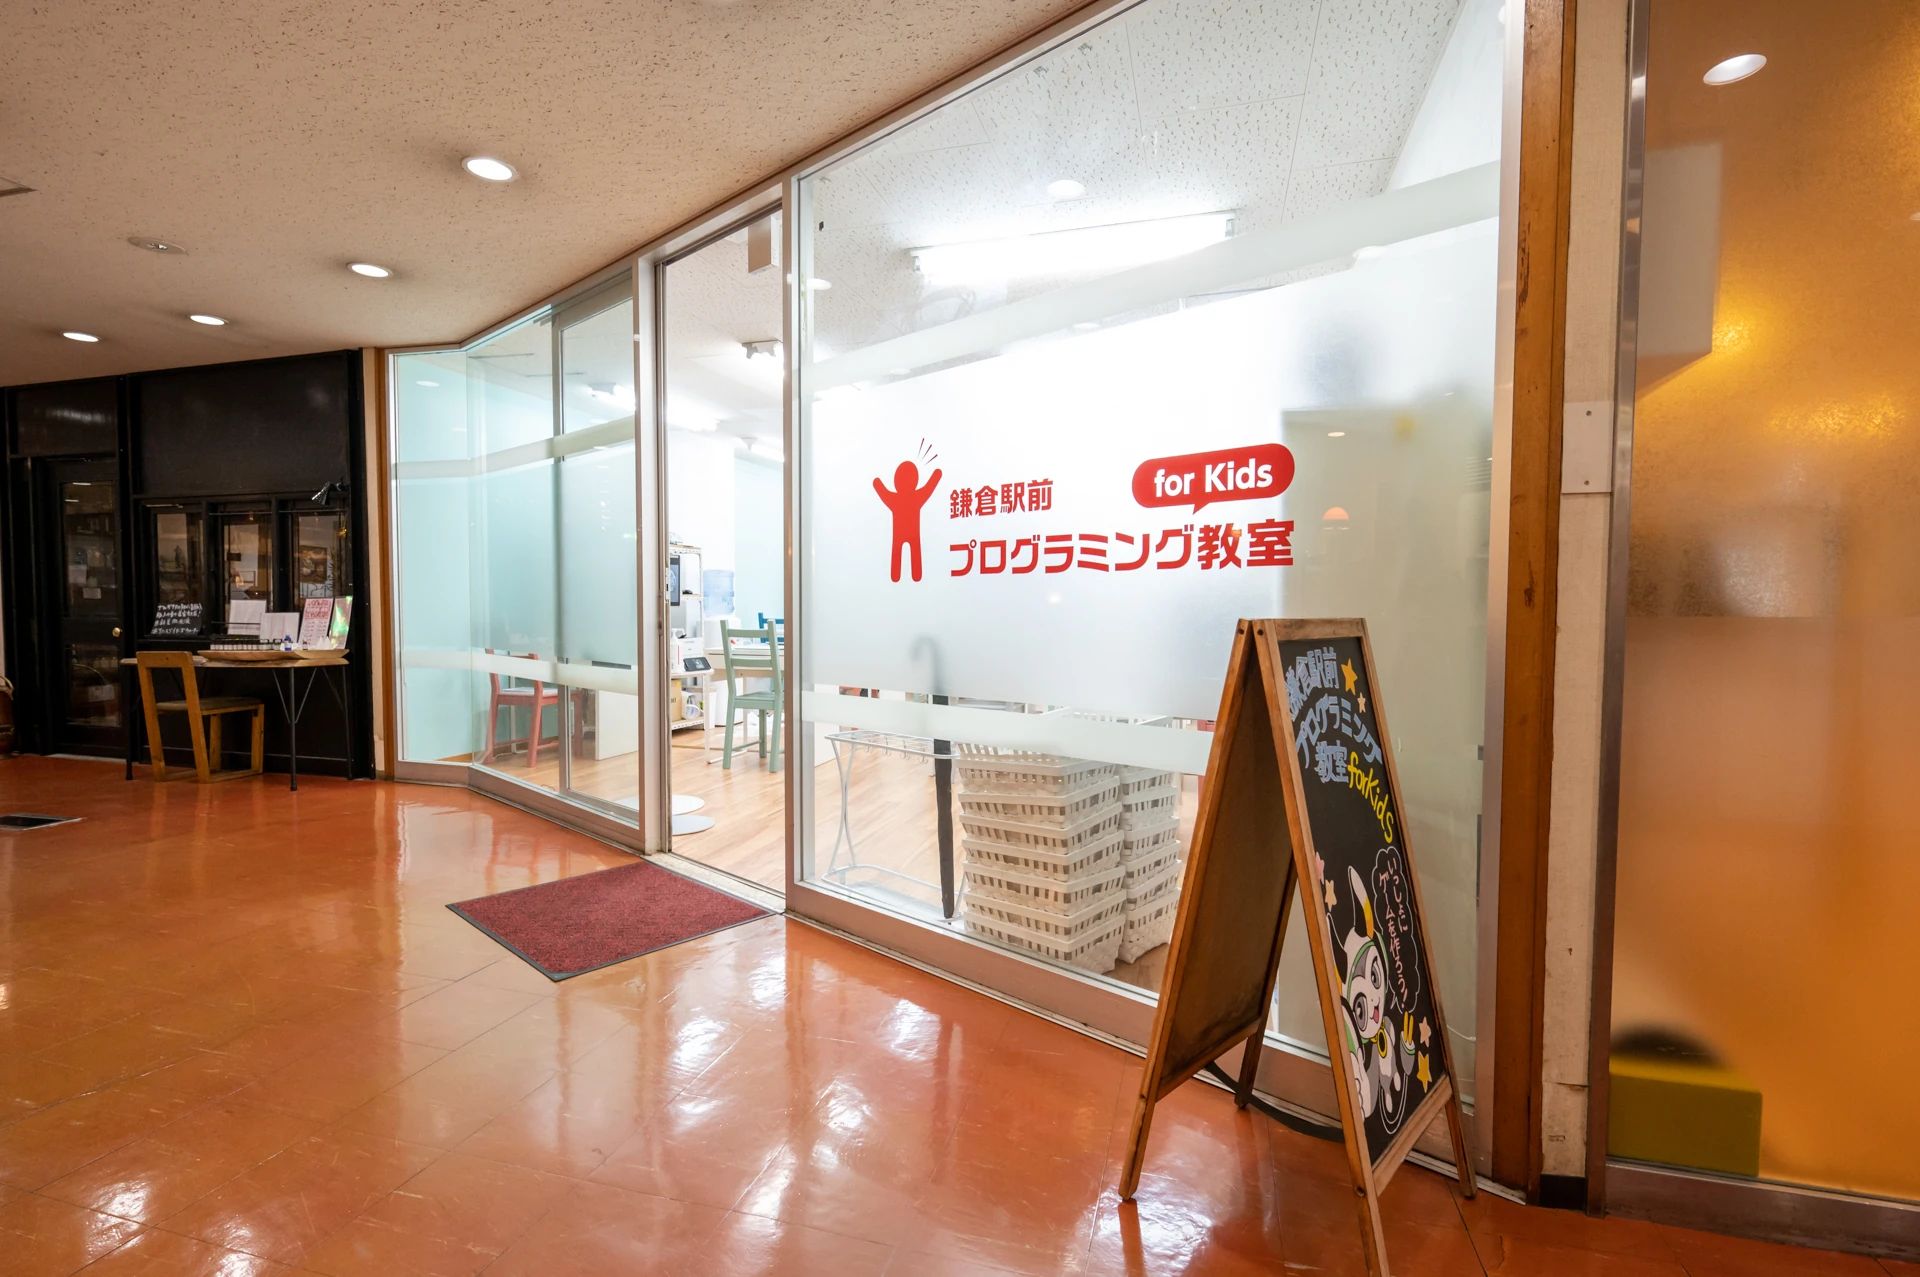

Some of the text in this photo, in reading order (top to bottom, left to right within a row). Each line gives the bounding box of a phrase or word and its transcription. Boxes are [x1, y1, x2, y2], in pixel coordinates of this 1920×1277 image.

[950, 478, 1054, 519] 鎌倉駅前
[1153, 458, 1274, 498] for Kids
[949, 518, 1296, 577] プログラミング教室
[1285, 646, 1340, 721] 鎌倉駅前
[1296, 692, 1383, 769] プログラミング
[1314, 739, 1349, 783] 教室
[1387, 857, 1409, 933] いっしょに
